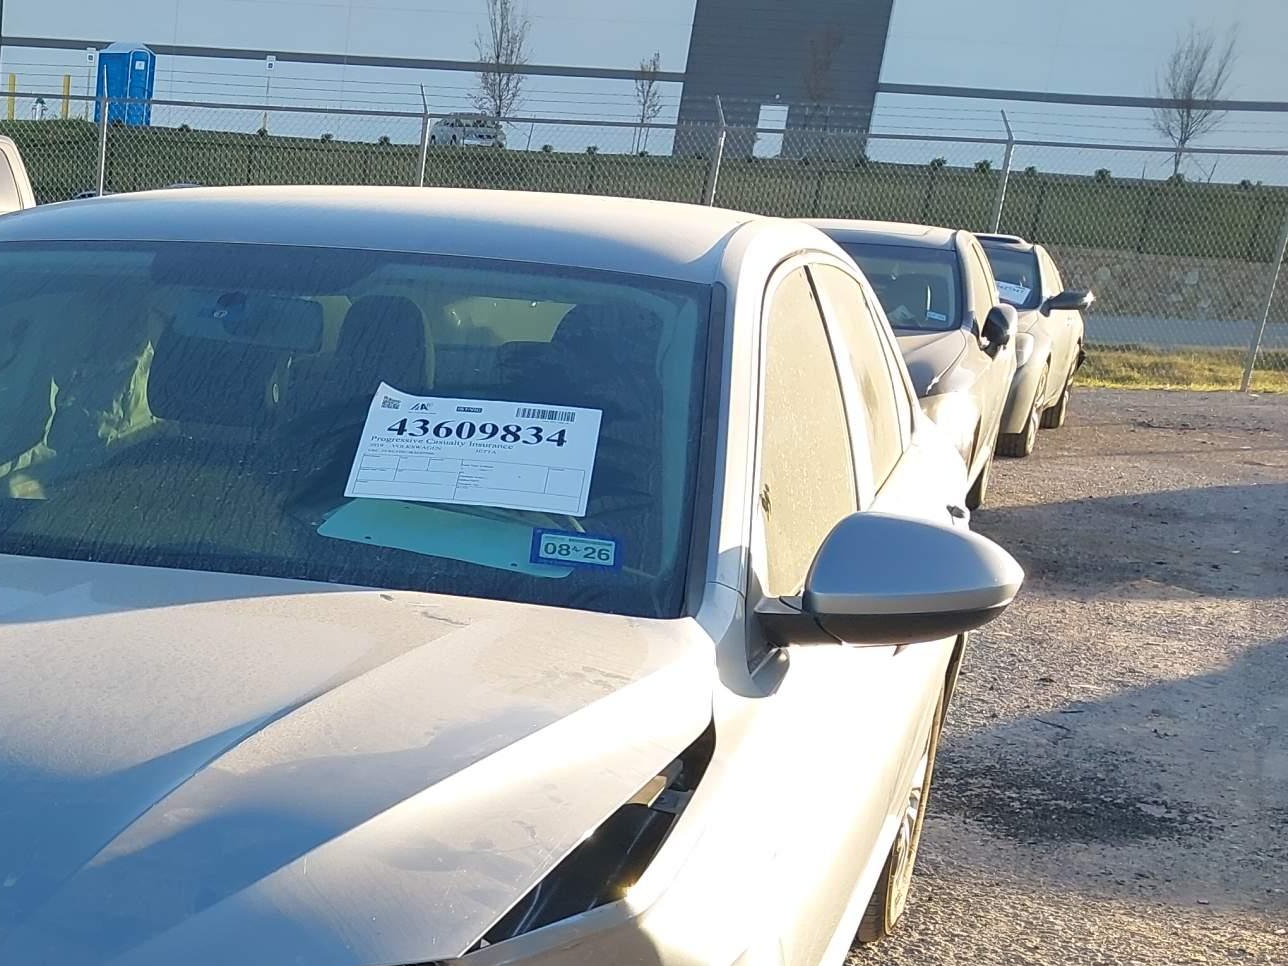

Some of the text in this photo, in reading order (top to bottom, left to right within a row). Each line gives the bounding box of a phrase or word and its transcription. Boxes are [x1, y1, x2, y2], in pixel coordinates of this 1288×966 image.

[386, 417, 568, 447] 43609834
[371, 435, 513, 450] Progressive Casualty Insurance
[543, 542, 610, 561] 08 26
